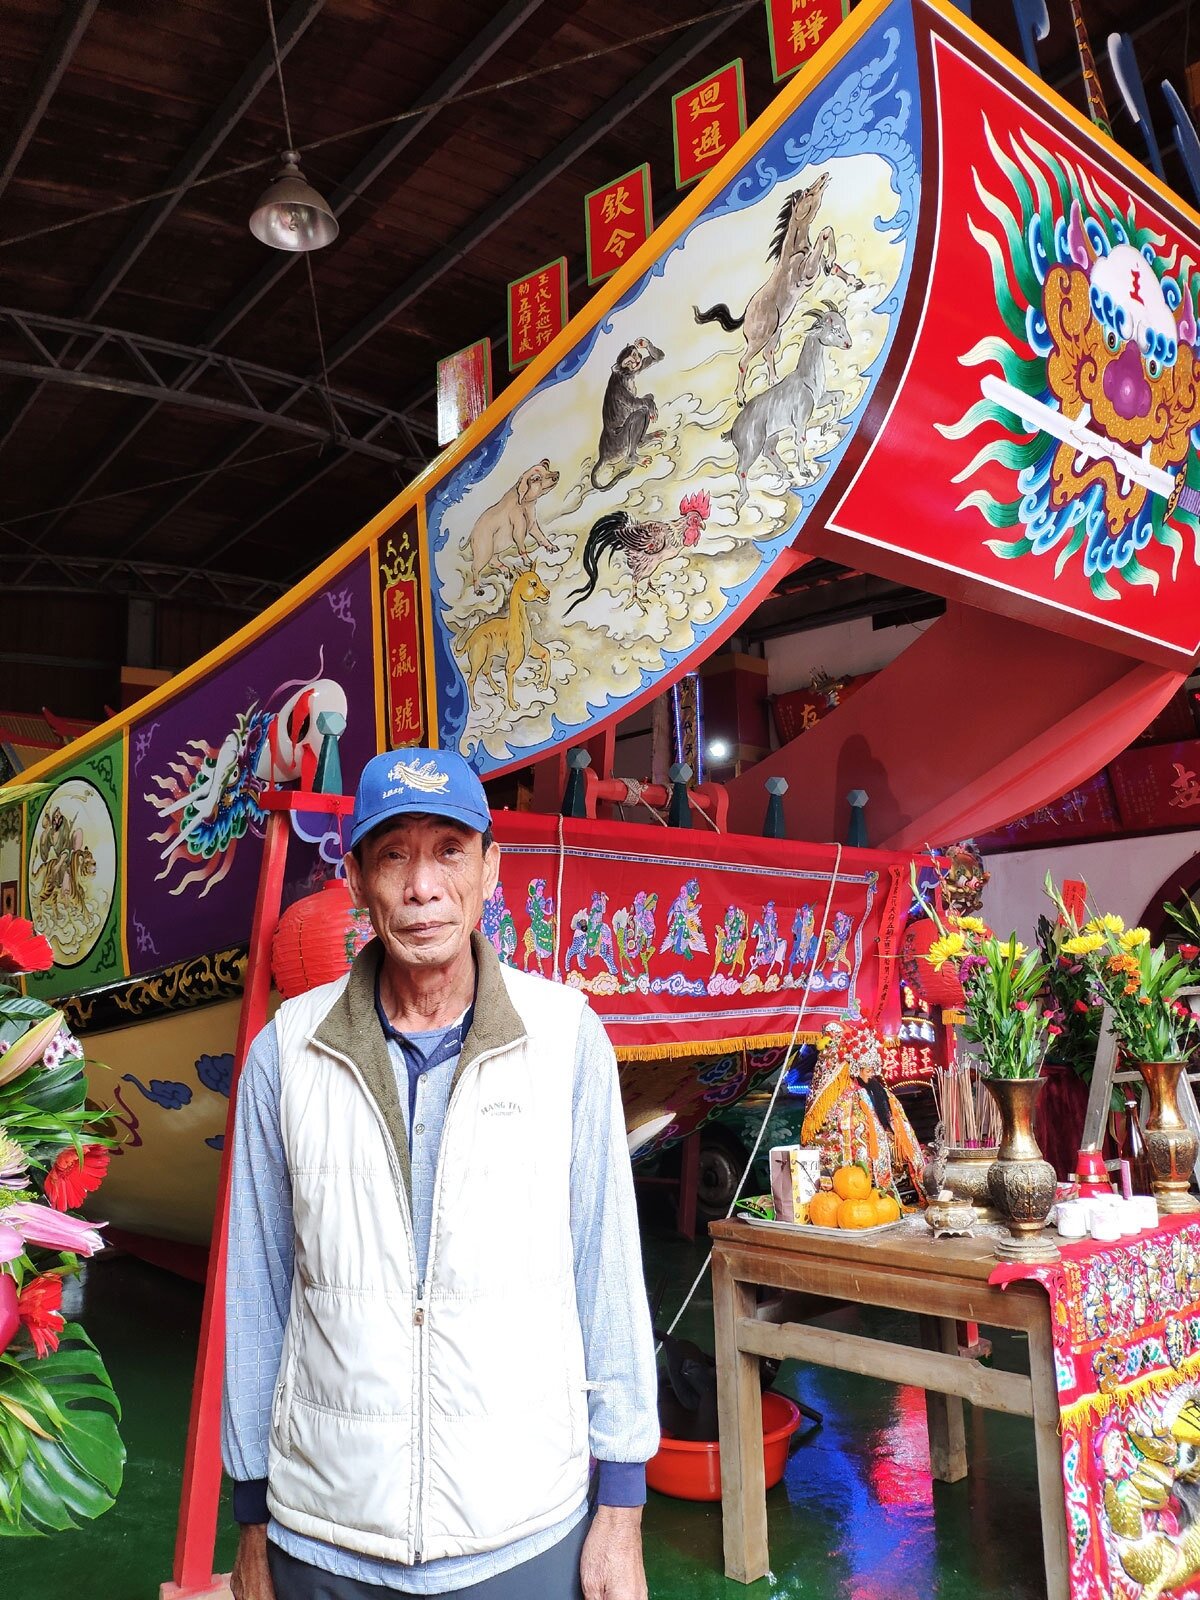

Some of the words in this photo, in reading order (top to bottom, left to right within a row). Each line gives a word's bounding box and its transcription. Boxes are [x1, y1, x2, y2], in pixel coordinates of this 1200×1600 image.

[600, 186, 636, 258] 欽令
[390, 589, 420, 733] 南瀛號
